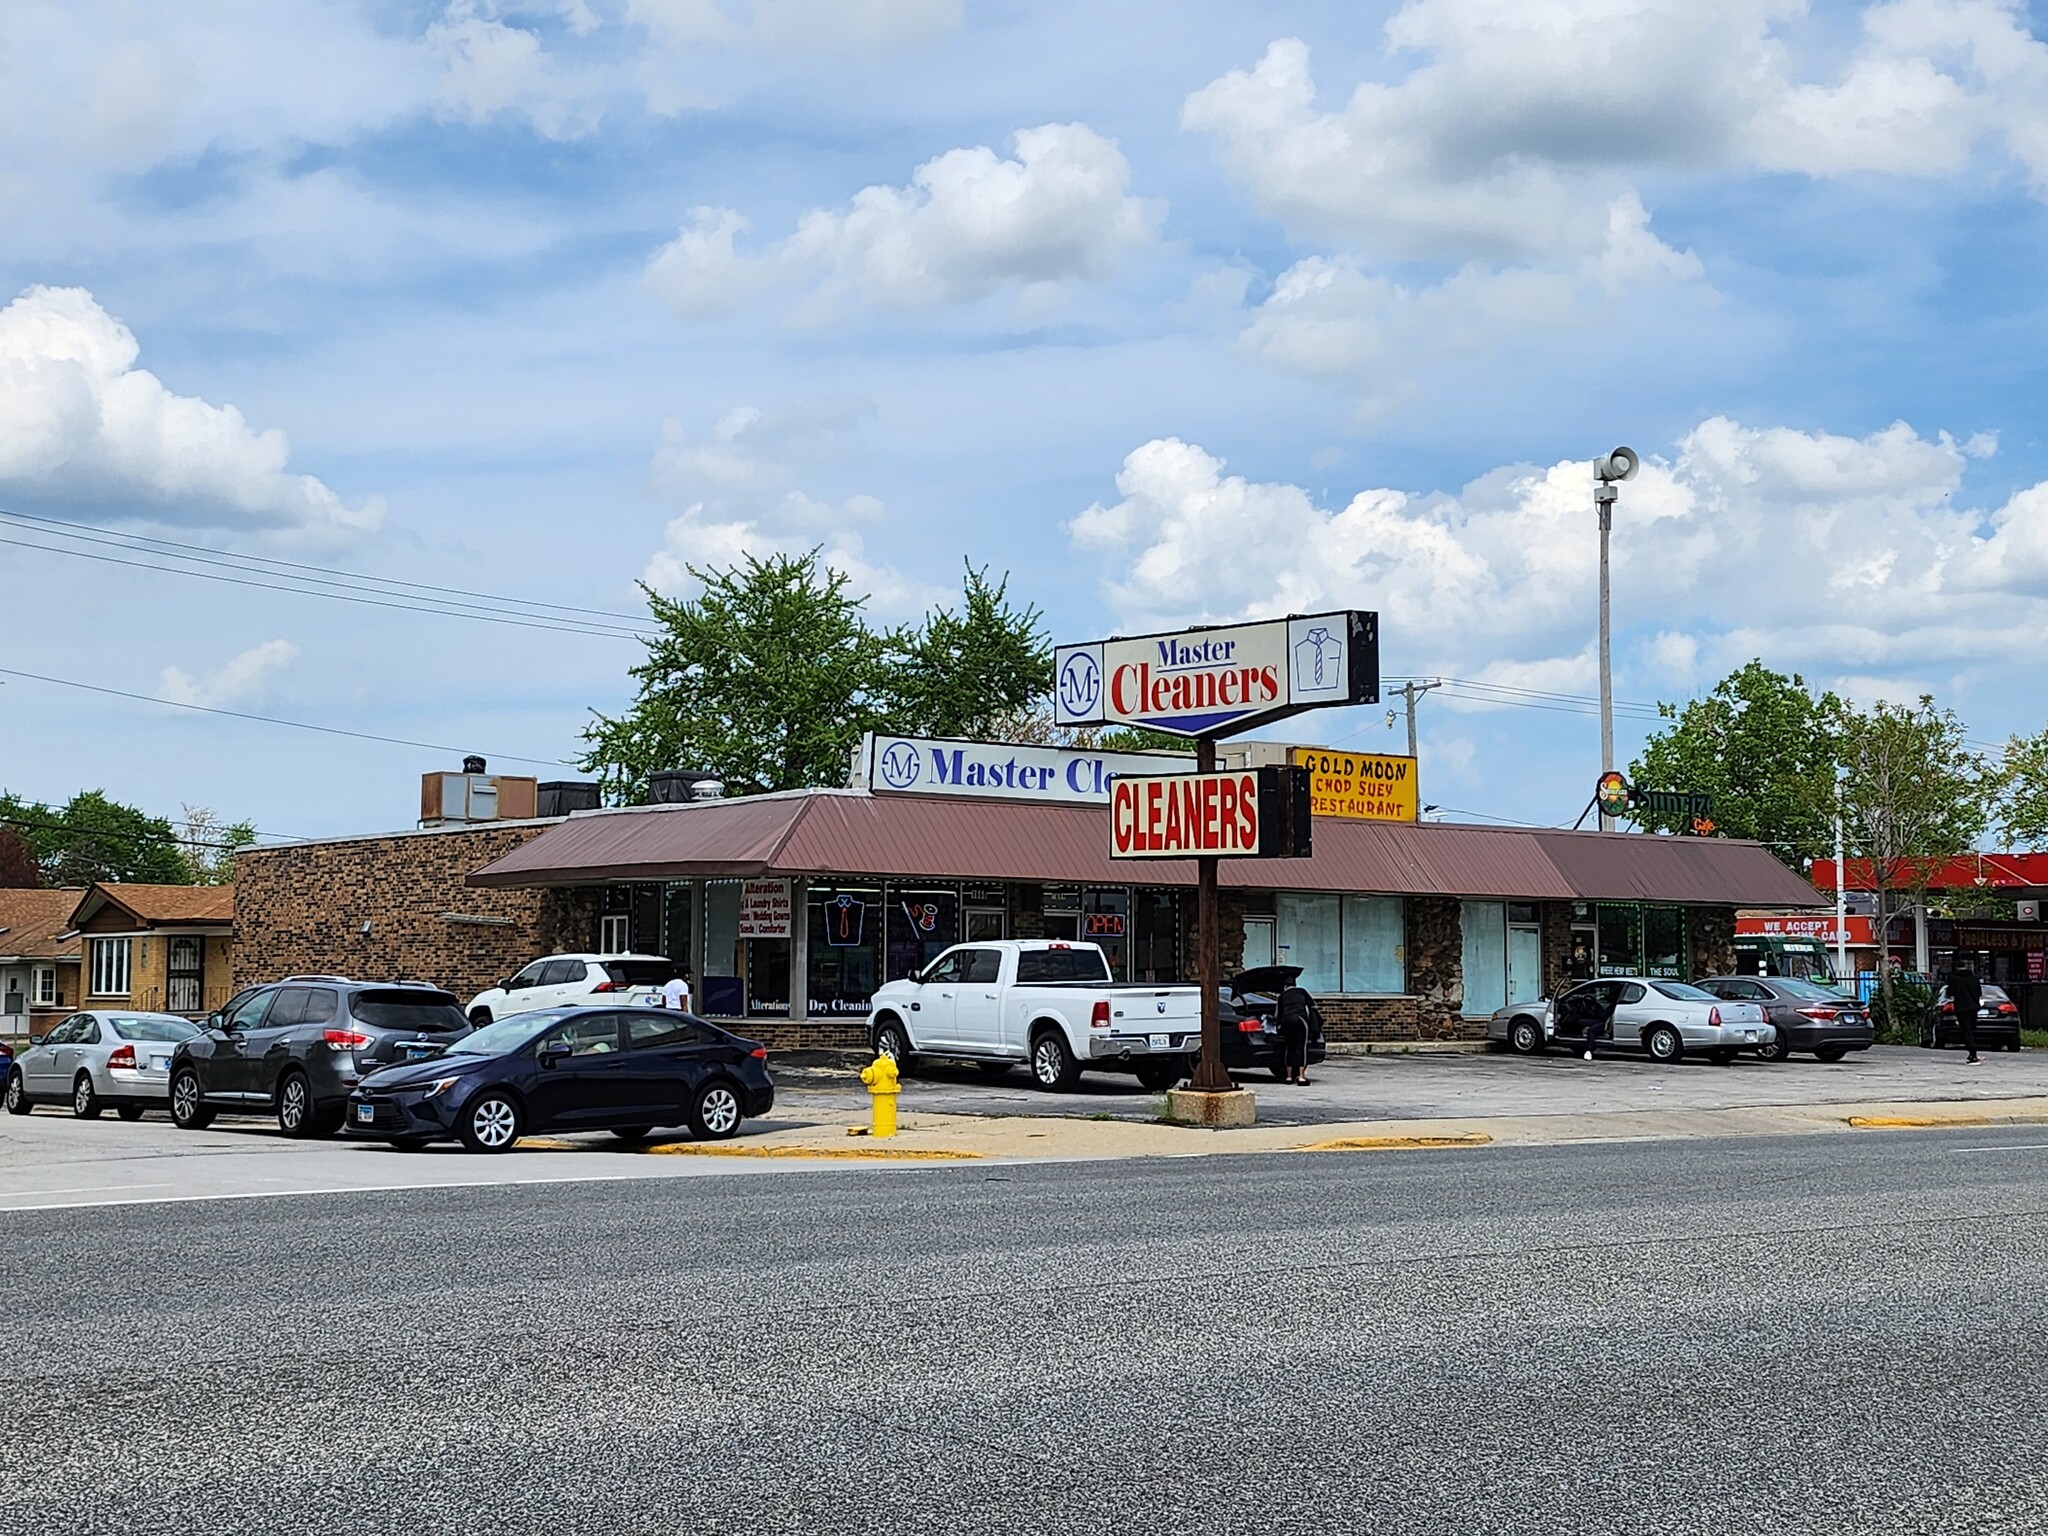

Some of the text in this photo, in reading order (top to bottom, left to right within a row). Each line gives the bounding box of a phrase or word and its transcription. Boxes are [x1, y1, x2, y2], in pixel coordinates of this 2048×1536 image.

[1156, 638, 1236, 668] Master
[1111, 662, 1278, 716] Cleaners
[926, 747, 1055, 791] Master
[1305, 755, 1407, 781] GOLD MOON
[1358, 781, 1393, 798] SUEY
[1636, 781, 1715, 815] Sunrize
[1113, 775, 1257, 854] CLEANERS
[1310, 796, 1405, 817] RESTAURANT
[745, 881, 784, 894] Alteration
[750, 898, 770, 911] Laundry
[772, 897, 789, 908] Shirts
[1086, 915, 1123, 934] OPEN
[1763, 921, 1829, 931] WE ACCEPT
[1821, 931, 1852, 941] CAD
[1649, 967, 1680, 976] THE SOUL
[808, 998, 873, 1014] Dry Cleanin
